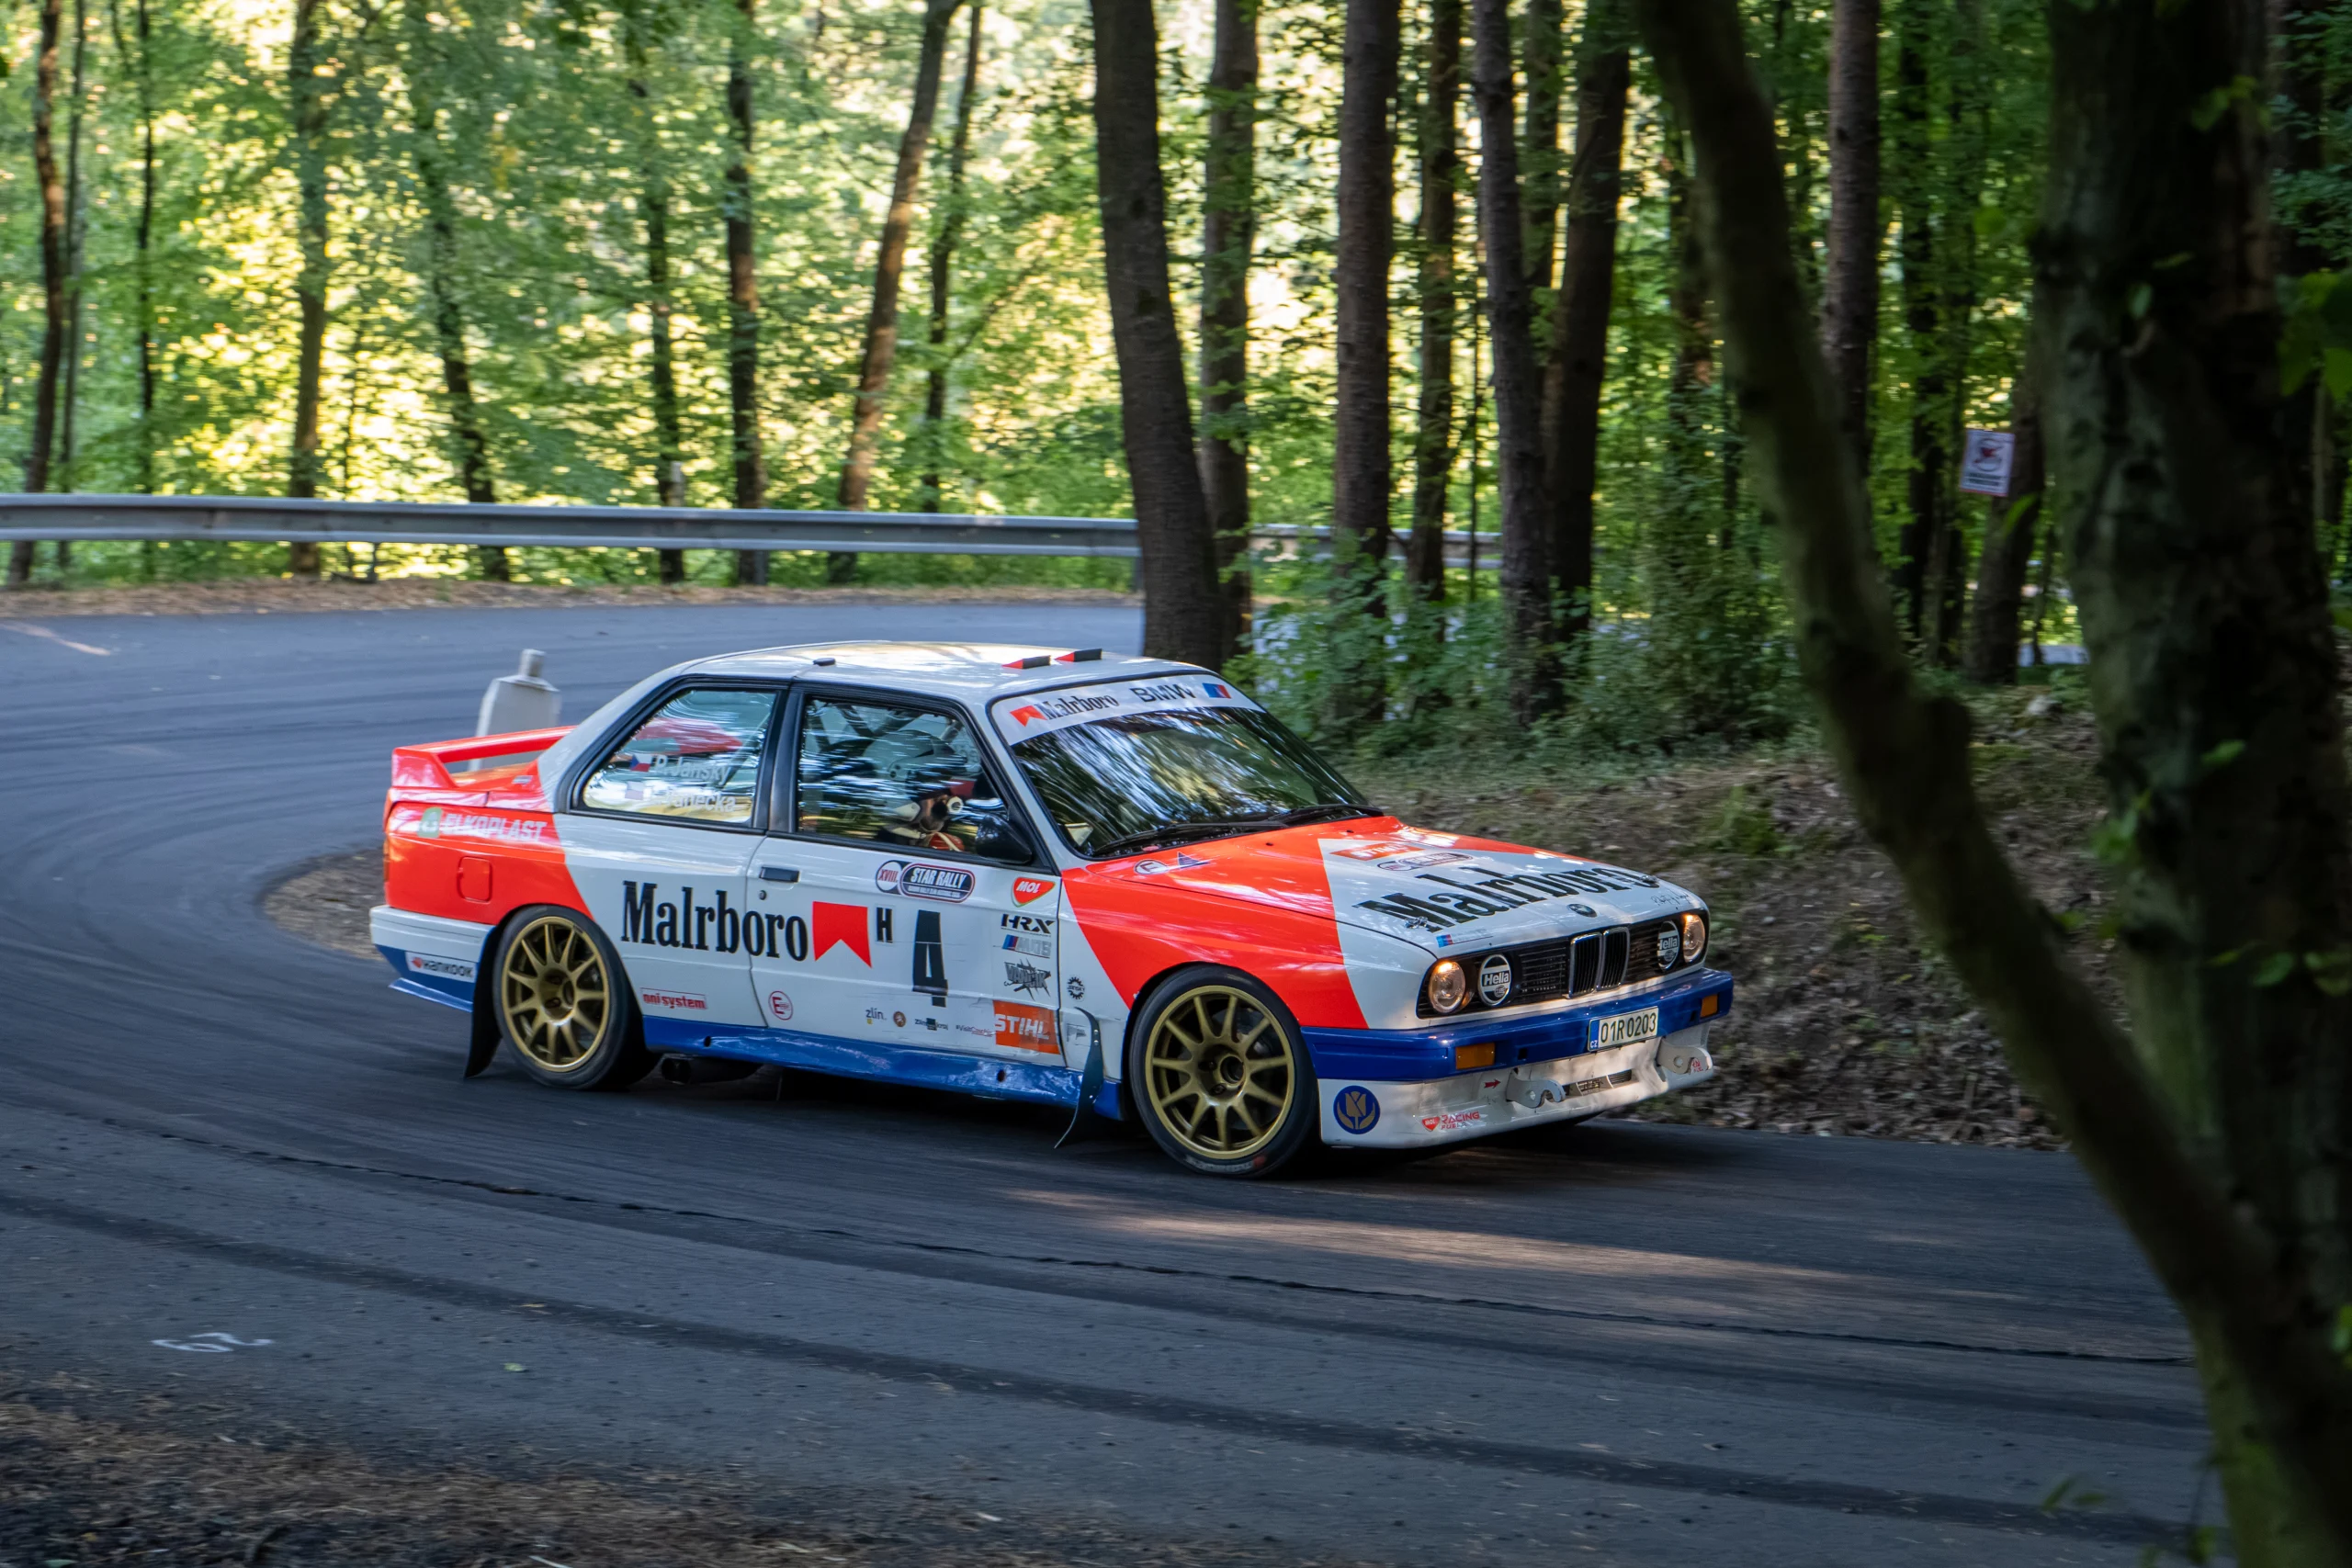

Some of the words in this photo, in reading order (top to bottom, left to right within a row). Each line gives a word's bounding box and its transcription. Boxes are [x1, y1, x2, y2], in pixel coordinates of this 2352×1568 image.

[1035, 694, 1120, 720] Malrboro
[1129, 683, 1197, 703] BMW
[441, 813, 548, 842] ELKOPLAST
[910, 867, 936, 886] STAR
[936, 871, 967, 889] RALLY
[1016, 881, 1041, 894] MOL
[1352, 866, 1660, 934] Malrboro
[621, 880, 808, 963] Malrboro
[876, 907, 893, 943] H
[1001, 913, 1055, 934] HRX
[912, 908, 948, 1008] 4
[1484, 971, 1510, 987] Hella
[994, 1013, 1050, 1040] STIHL
[1600, 1020, 1625, 1043] 01R
[1626, 1012, 1657, 1037] 0203
[1589, 1039, 1599, 1049] CZ
[1441, 1111, 1480, 1123] RACING
